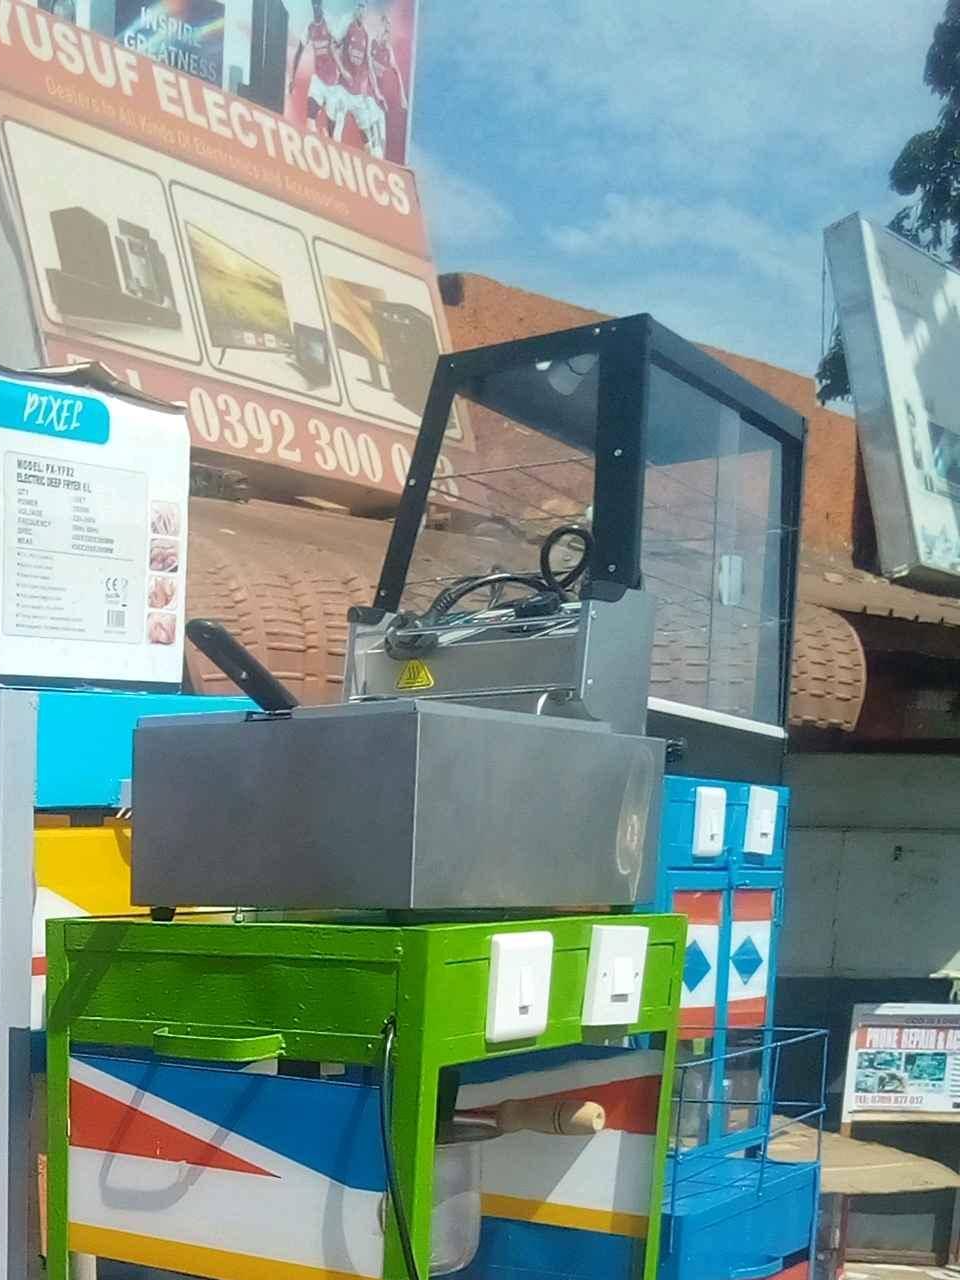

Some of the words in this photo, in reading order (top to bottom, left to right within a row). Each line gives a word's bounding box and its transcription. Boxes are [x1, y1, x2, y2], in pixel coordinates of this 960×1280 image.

[123, 31, 217, 81] GREATNESS
[151, 64, 411, 216] ELECTRONICS
[190, 386, 302, 464] 0392
[307, 417, 384, 483] 300
